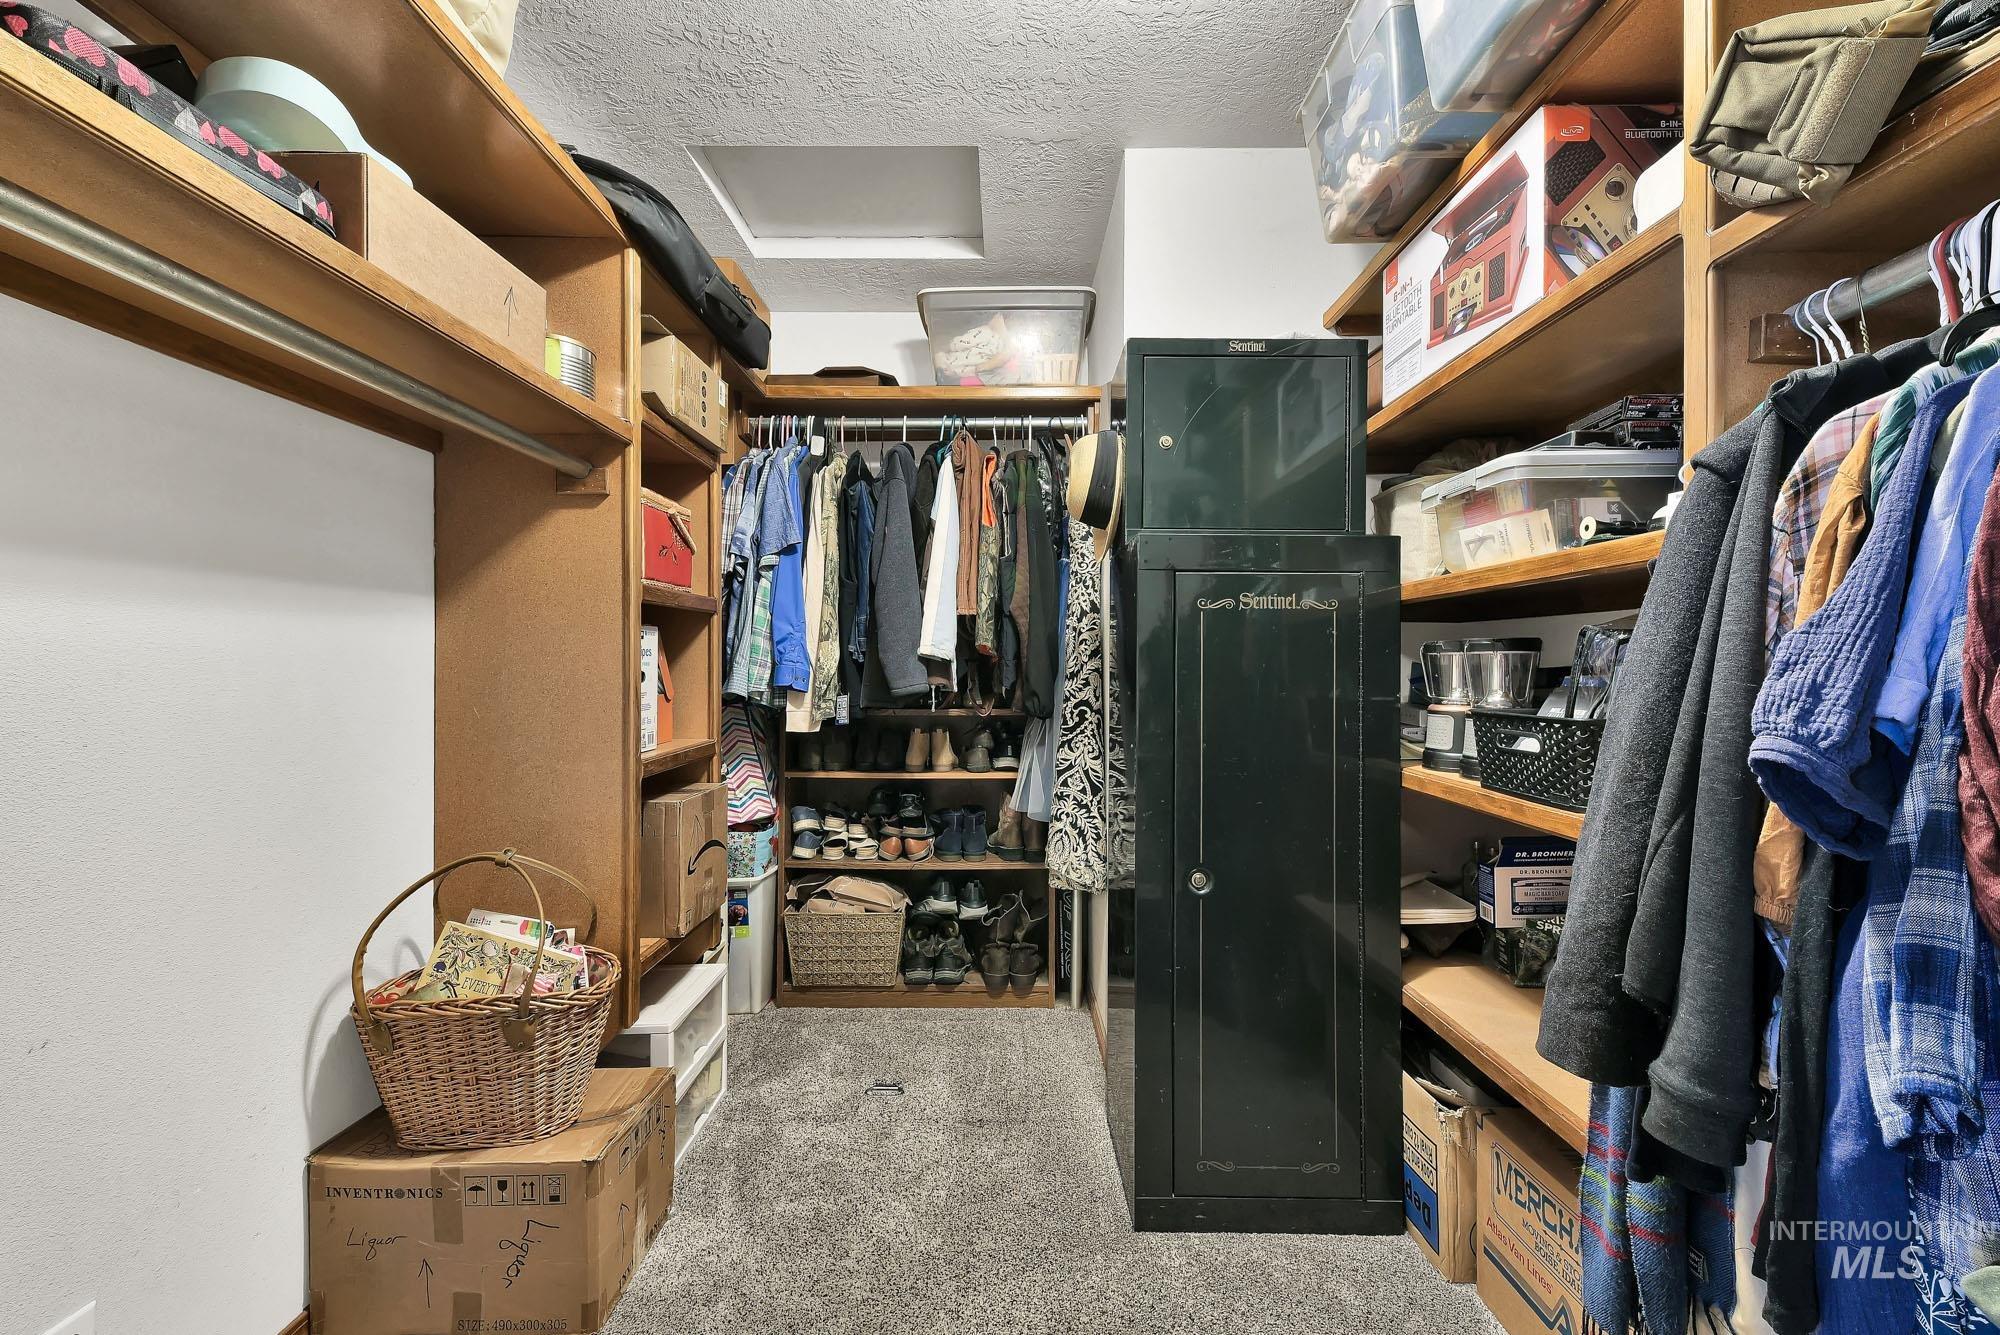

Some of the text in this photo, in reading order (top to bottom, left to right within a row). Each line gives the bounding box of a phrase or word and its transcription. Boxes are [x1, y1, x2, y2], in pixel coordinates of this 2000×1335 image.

[1625, 130, 1671, 139] BLUETOOTH
[1393, 276, 1413, 303] 6-IN-1
[1385, 284, 1422, 326] BLUETOOTH
[1386, 297, 1422, 336] TURNTABLE
[1228, 340, 1266, 352] Sentinel
[1239, 592, 1298, 611] Sentinel
[1536, 920, 1564, 935] SPR
[1494, 1151, 1581, 1254] MERCH
[1522, 1216, 1554, 1258] MOVING
[1486, 1217, 1552, 1295] Atlas Van Lines
[457, 1317, 567, 1332] SIZE:490x300x305
